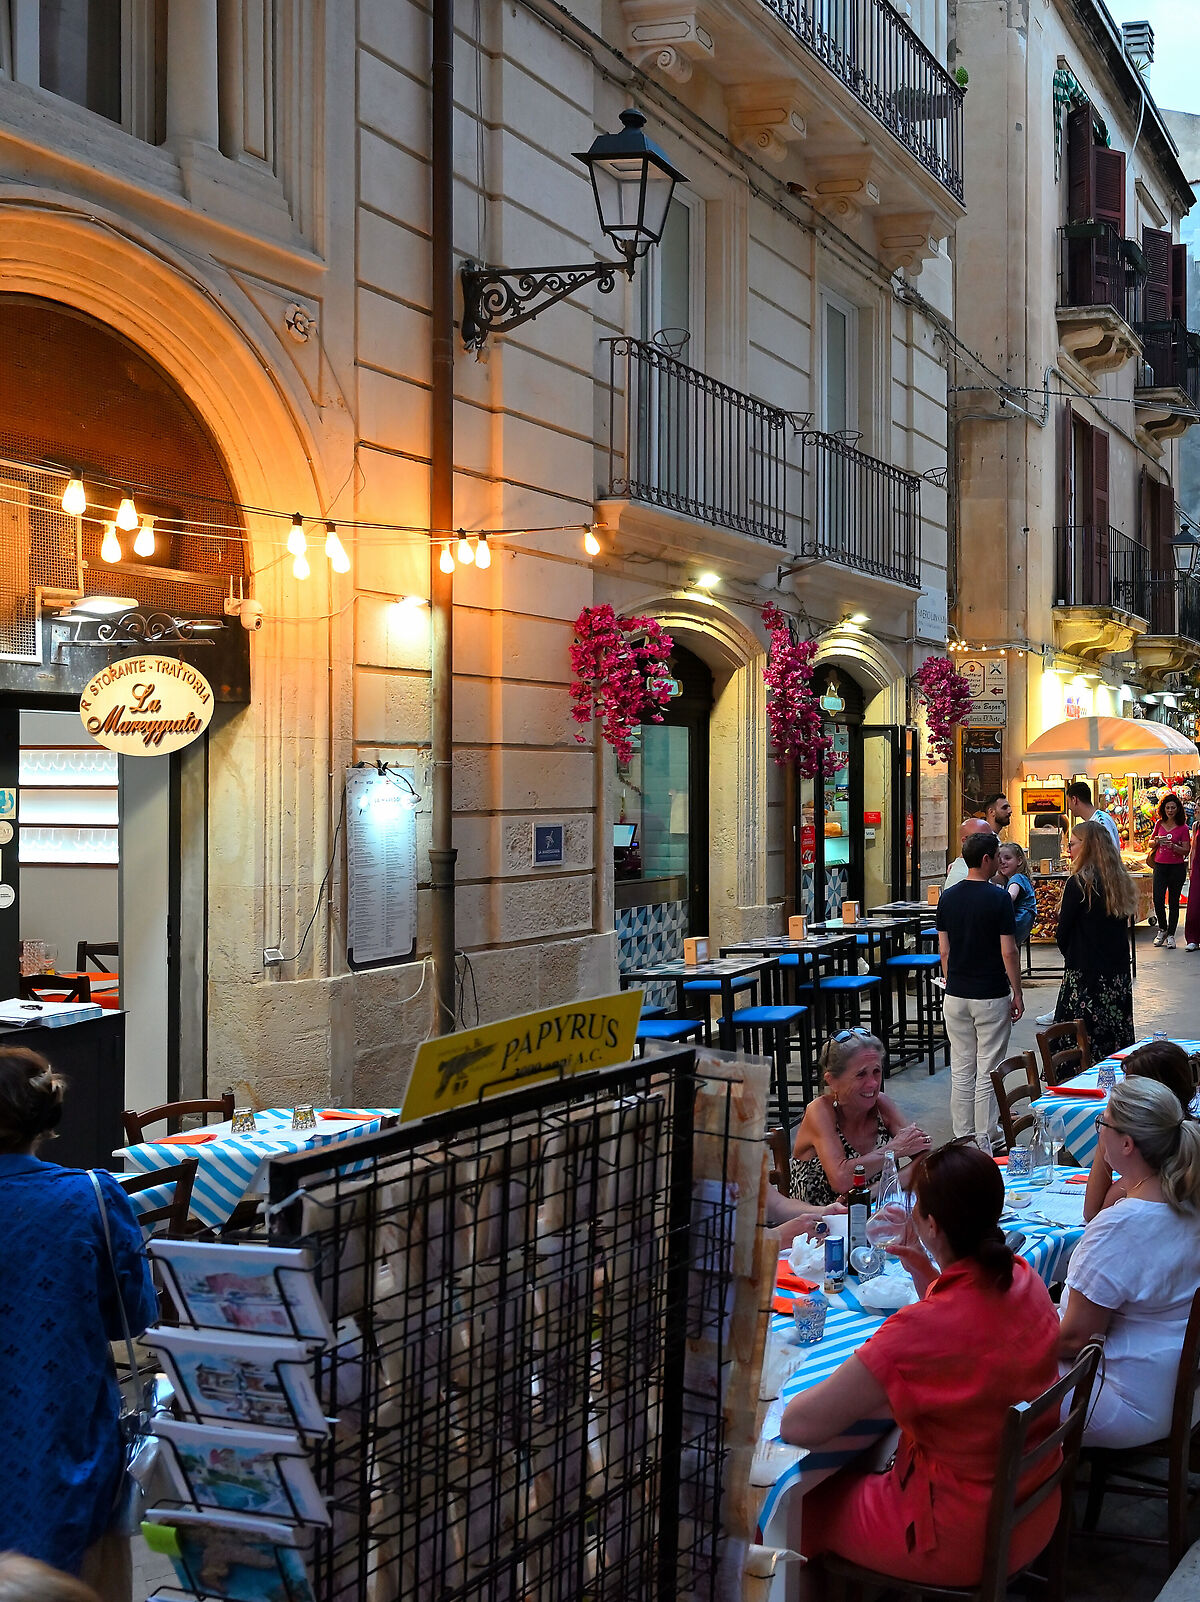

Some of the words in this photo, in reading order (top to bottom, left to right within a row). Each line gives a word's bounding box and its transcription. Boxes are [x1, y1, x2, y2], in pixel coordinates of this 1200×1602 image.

[129, 683, 161, 713] La
[154, 660, 211, 704] TRATTORIA
[86, 704, 202, 745] Mareggiata
[502, 1013, 620, 1072] PAPYRUS
[574, 1048, 602, 1065] A.C.
